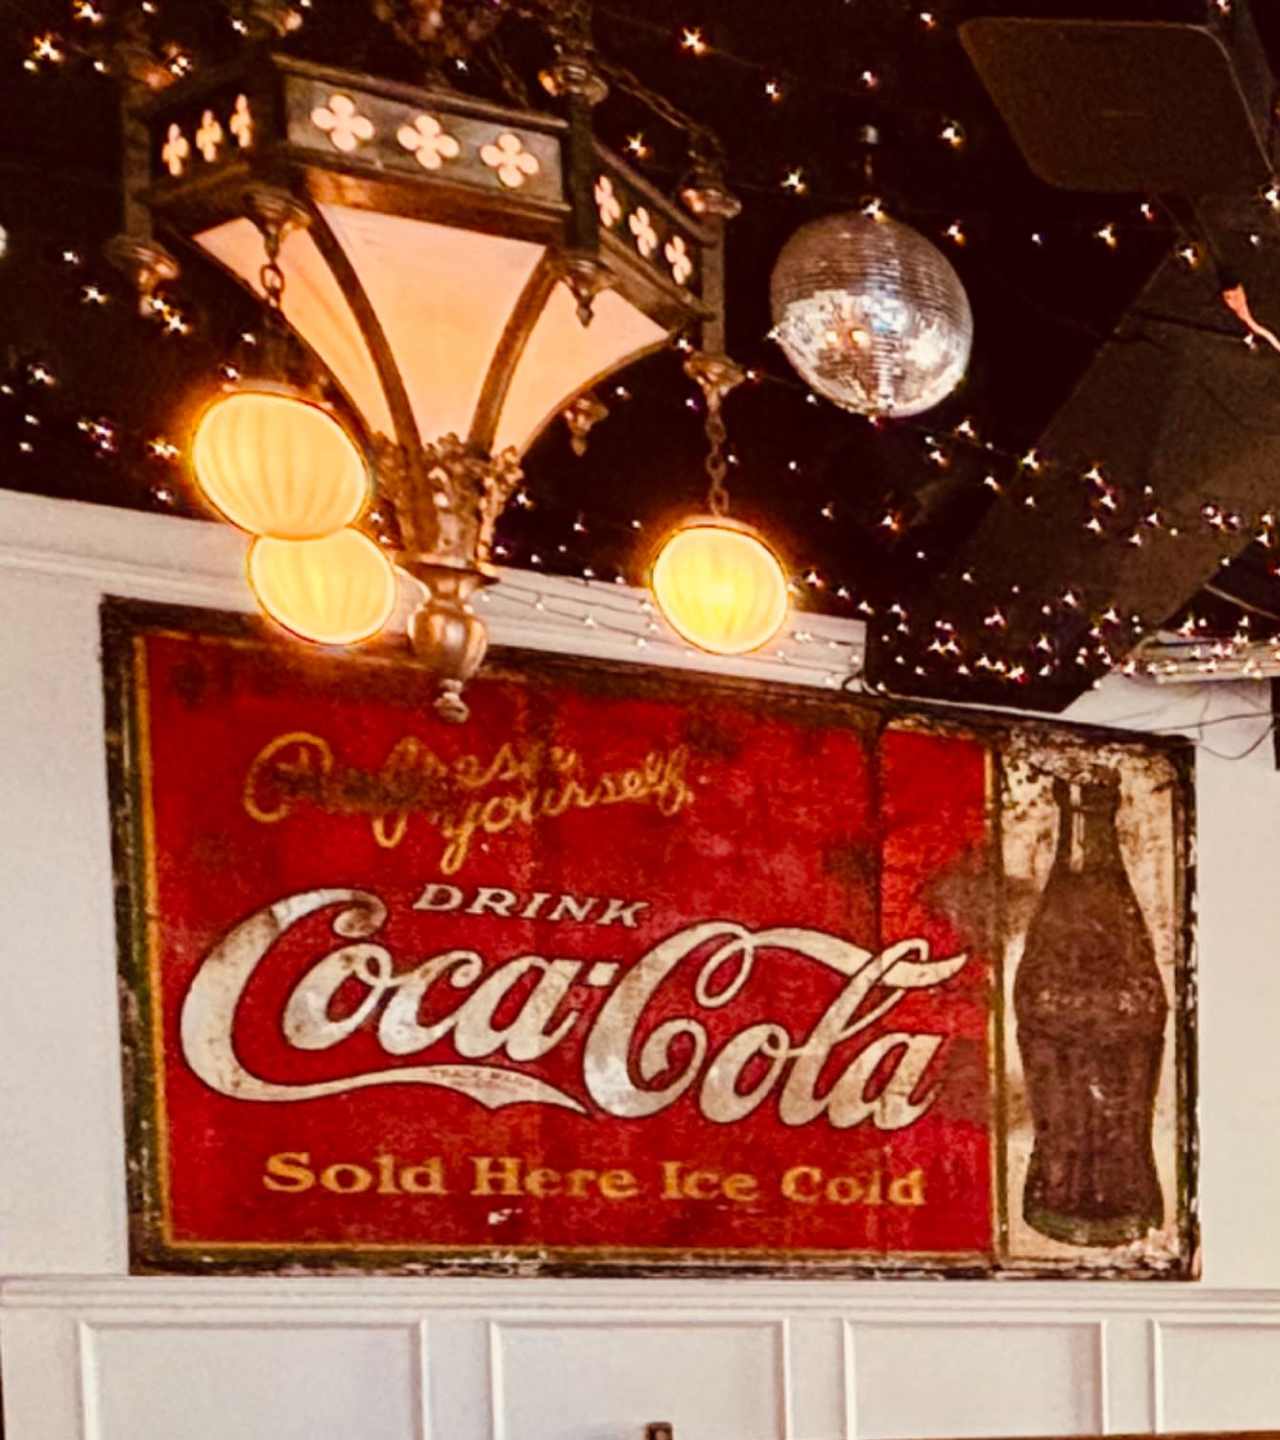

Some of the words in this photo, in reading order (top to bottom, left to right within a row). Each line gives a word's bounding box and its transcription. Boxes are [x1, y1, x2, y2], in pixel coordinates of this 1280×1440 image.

[244, 731, 577, 848] Rfres
[440, 745, 694, 874] yourself
[412, 883, 650, 928] DRINK
[180, 887, 968, 1130] Coca-Cola
[263, 1151, 449, 1196] Sold
[470, 1156, 637, 1200] Here
[660, 1160, 760, 1202] Ice
[781, 1166, 926, 1207] Cold
